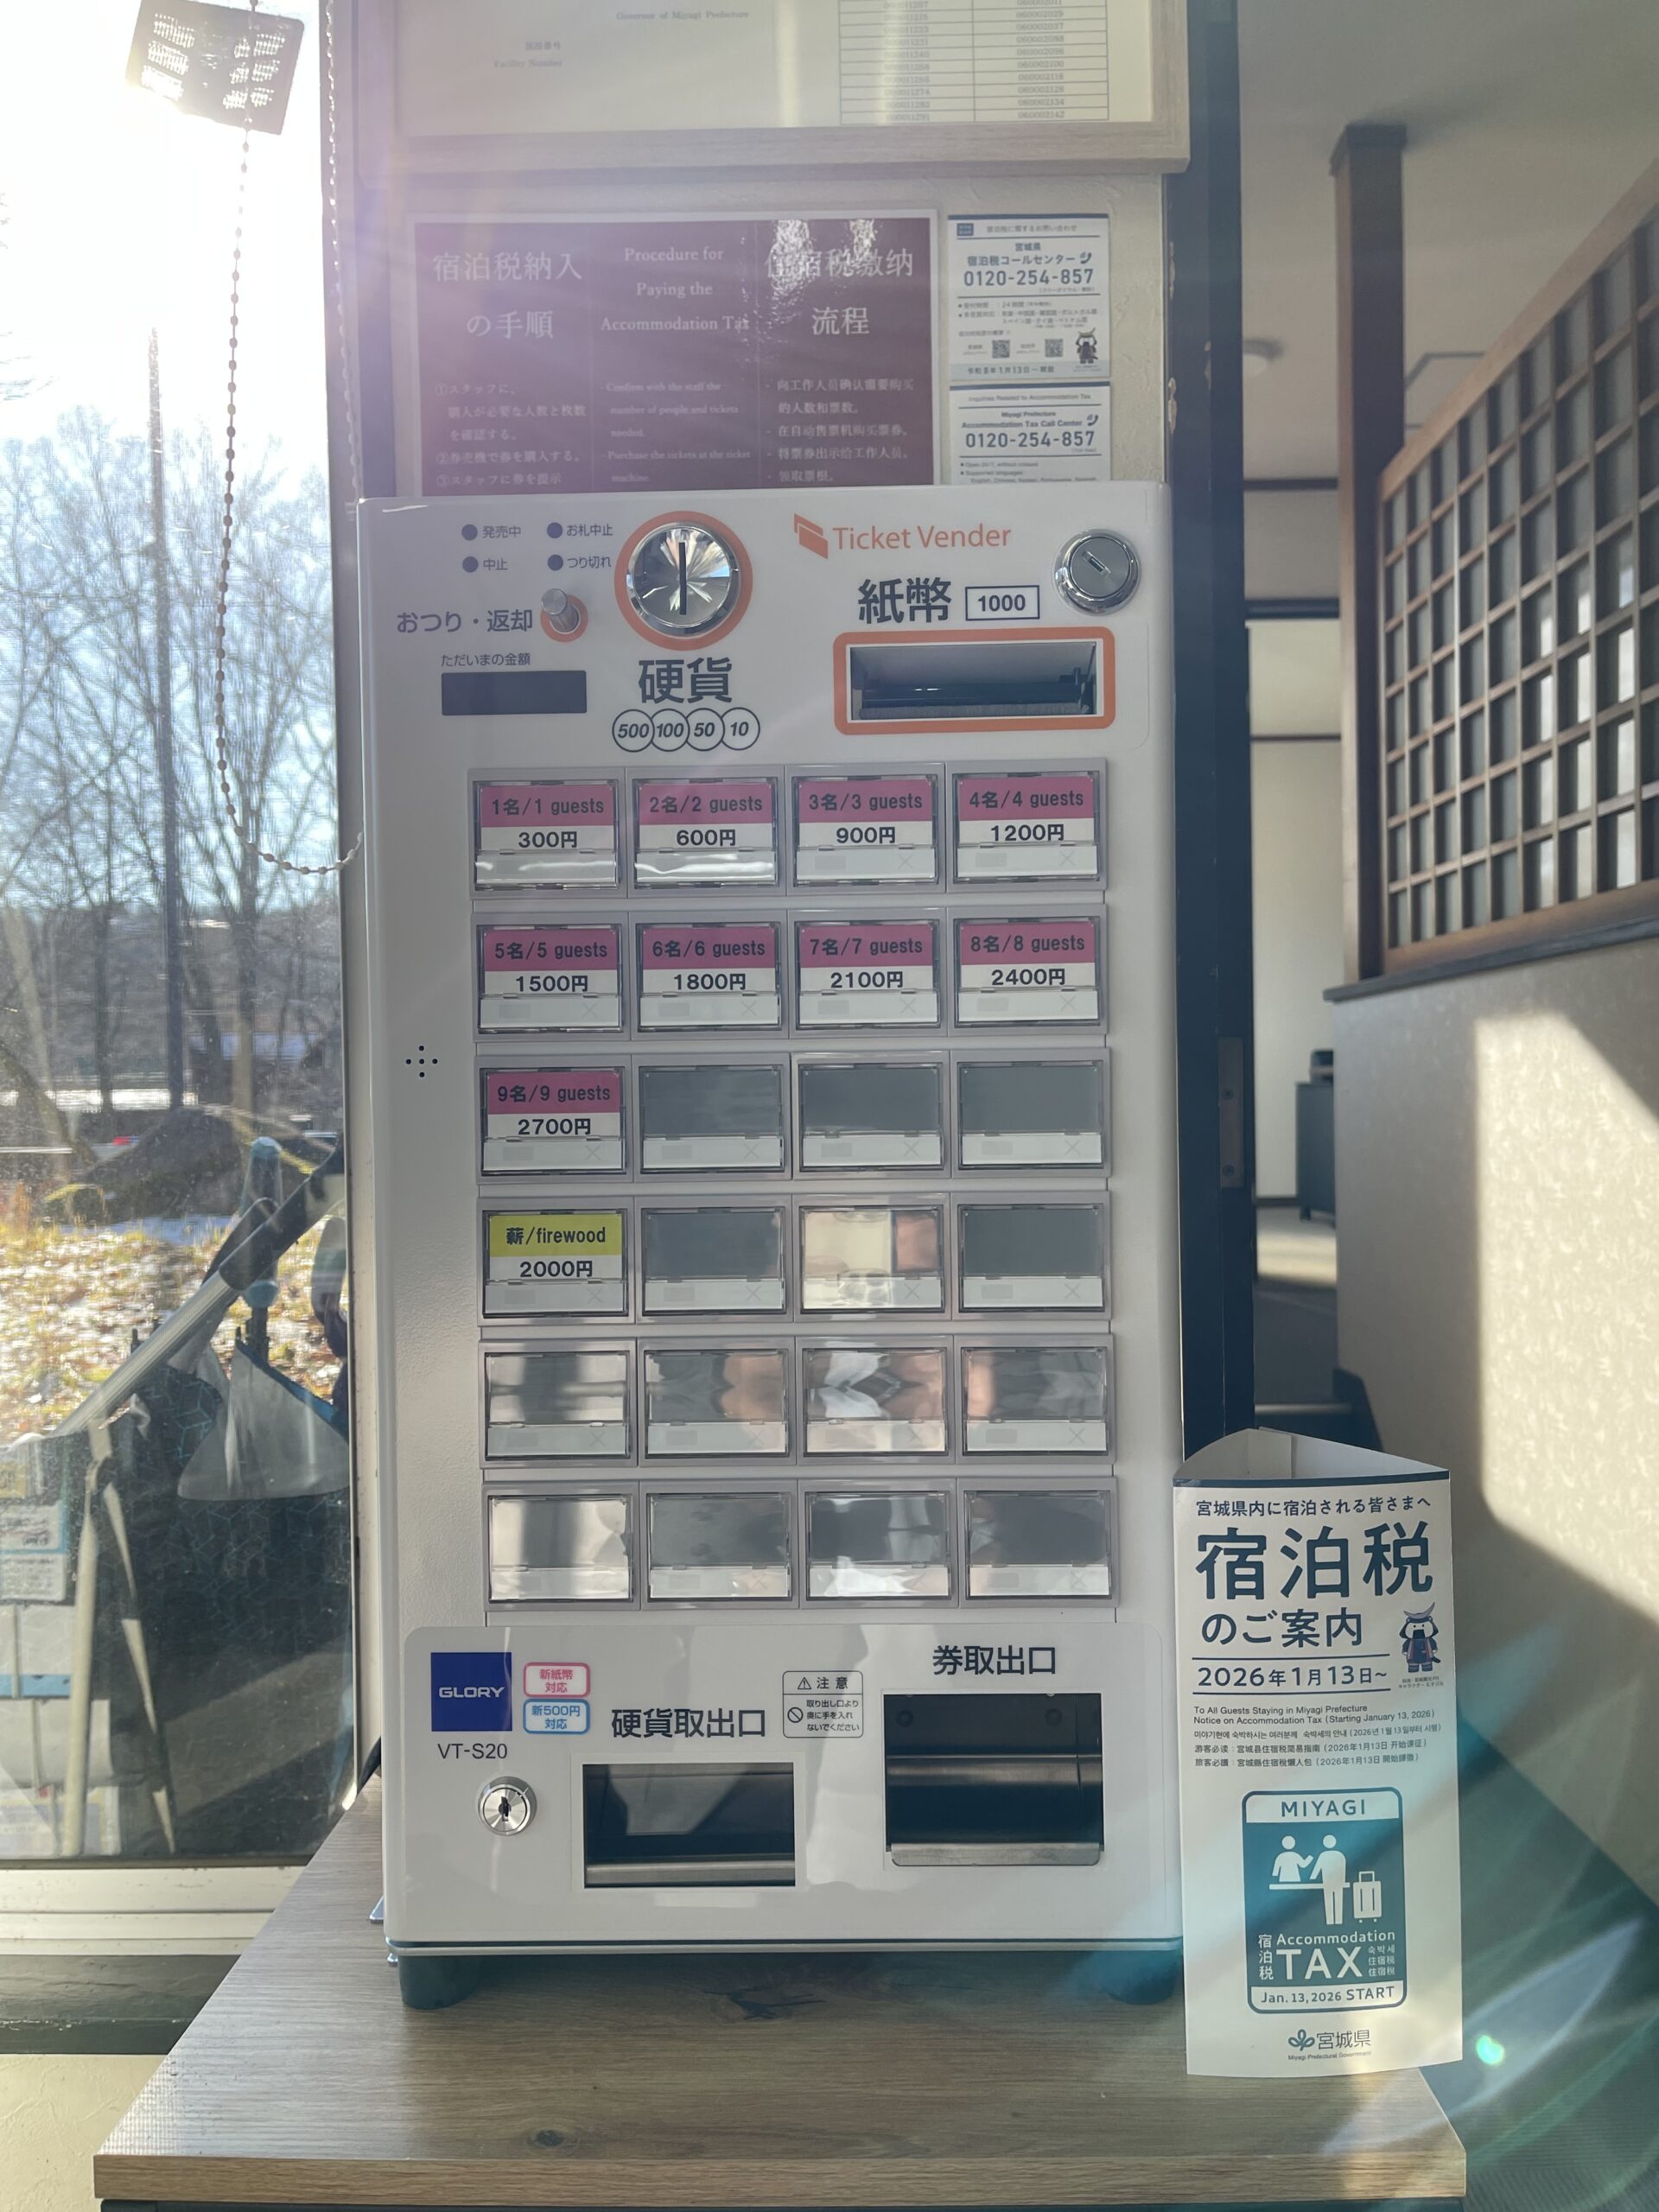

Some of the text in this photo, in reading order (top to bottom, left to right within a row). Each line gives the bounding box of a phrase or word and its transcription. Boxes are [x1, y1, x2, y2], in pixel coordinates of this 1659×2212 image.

[625, 245, 724, 261] Procedure for
[1014, 242, 1041, 251] 宮城県
[433, 251, 582, 282] 宿泊税納入
[967, 254, 1075, 266] 宿泊税コールセンター
[964, 268, 1094, 287] 0120-254-857
[636, 282, 713, 299] Paying the
[467, 310, 553, 339] の手順
[601, 315, 749, 330] Accommodation Tax
[812, 306, 869, 335] 流程
[610, 405, 645, 415] number
[658, 404, 688, 416] people
[691, 404, 707, 414] and
[709, 404, 738, 414] tickets
[966, 430, 1095, 448] 0120-254-857
[608, 451, 648, 460] Purchase
[650, 450, 665, 459] the
[709, 449, 724, 458] the
[726, 449, 750, 458] ticket
[482, 525, 522, 539] 発売中
[566, 524, 613, 537] お札中止
[832, 524, 1011, 550] Ticket Vender
[483, 558, 508, 571] 中止
[566, 556, 612, 569] つり切れ
[857, 577, 951, 624] 紙幣
[976, 594, 1027, 612] 1000
[397, 608, 533, 633] おつり・返却
[441, 653, 531, 667] ただいまの金額
[638, 657, 733, 703] 硬貨
[618, 721, 748, 738] 500 100 50 10
[493, 798, 604, 816] 1名/1 guests
[650, 796, 762, 814] 2名/2 guests
[809, 793, 923, 810] 3名/3 guests
[969, 790, 1084, 809] 4名/4 guests
[518, 831, 577, 849] 300円
[676, 829, 736, 847] 600円
[836, 826, 896, 843] 900円
[990, 823, 1065, 842] 1200円
[494, 942, 608, 959] 5名/5 guests
[652, 940, 766, 957] 6名/6 guests
[810, 938, 923, 956] 7名/7 guests
[971, 935, 1085, 954] 8名/8 guests
[516, 975, 588, 992] 1500円
[674, 973, 747, 990] 1800円
[830, 971, 904, 988] 2100円
[991, 968, 1065, 987] 2400円
[498, 1084, 610, 1103] 9名/9 guests
[518, 1118, 591, 1135] 2700円
[506, 1227, 606, 1246] 薪/firewood
[520, 1260, 593, 1278] 2000円
[1196, 1495, 1431, 1517] 宮城県内に宿泊される皆さまへ
[1196, 1521, 1433, 1600] 宿泊税
[1201, 1607, 1362, 1648] のご案内
[932, 1645, 1056, 1675] 券取出口
[539, 1669, 574, 1681] 新紙幣
[817, 1676, 849, 1690] 注意
[439, 1687, 505, 1699] GLORY
[545, 1681, 568, 1694] 対応
[531, 1705, 581, 1717] 新500円
[806, 1699, 859, 1707] 取り出し口より
[1194, 1706, 1205, 1714] To
[1253, 1707, 1284, 1716] Staying
[1296, 1707, 1322, 1715] Miyagi
[612, 1707, 766, 1738] 硬貨取出口
[807, 1711, 854, 1719] 奥に手を入れ
[1194, 1716, 1221, 1725] Notice
[1236, 1716, 1305, 1725] Accommodation
[1363, 1713, 1395, 1722] January
[1412, 1709, 1434, 1719] 2026)
[544, 1718, 568, 1730] 対応
[1303, 1730, 1331, 1738] 숙박세의
[1350, 1728, 1379, 1737] (2026년
[1381, 1726, 1392, 1735] 1월
[437, 1743, 508, 1759] VT-S20
[1281, 1799, 1365, 1817] MIYAGI
[1275, 1930, 1396, 1946] Accommodation
[1258, 1934, 1274, 1980] 宿泊税
[1276, 1946, 1363, 1980] TAX
[1368, 1955, 1395, 1966] 住宿税
[1262, 1992, 1288, 2003] Jan.
[1346, 1986, 1395, 2001] START
[1316, 2029, 1371, 2050] 宮城県
